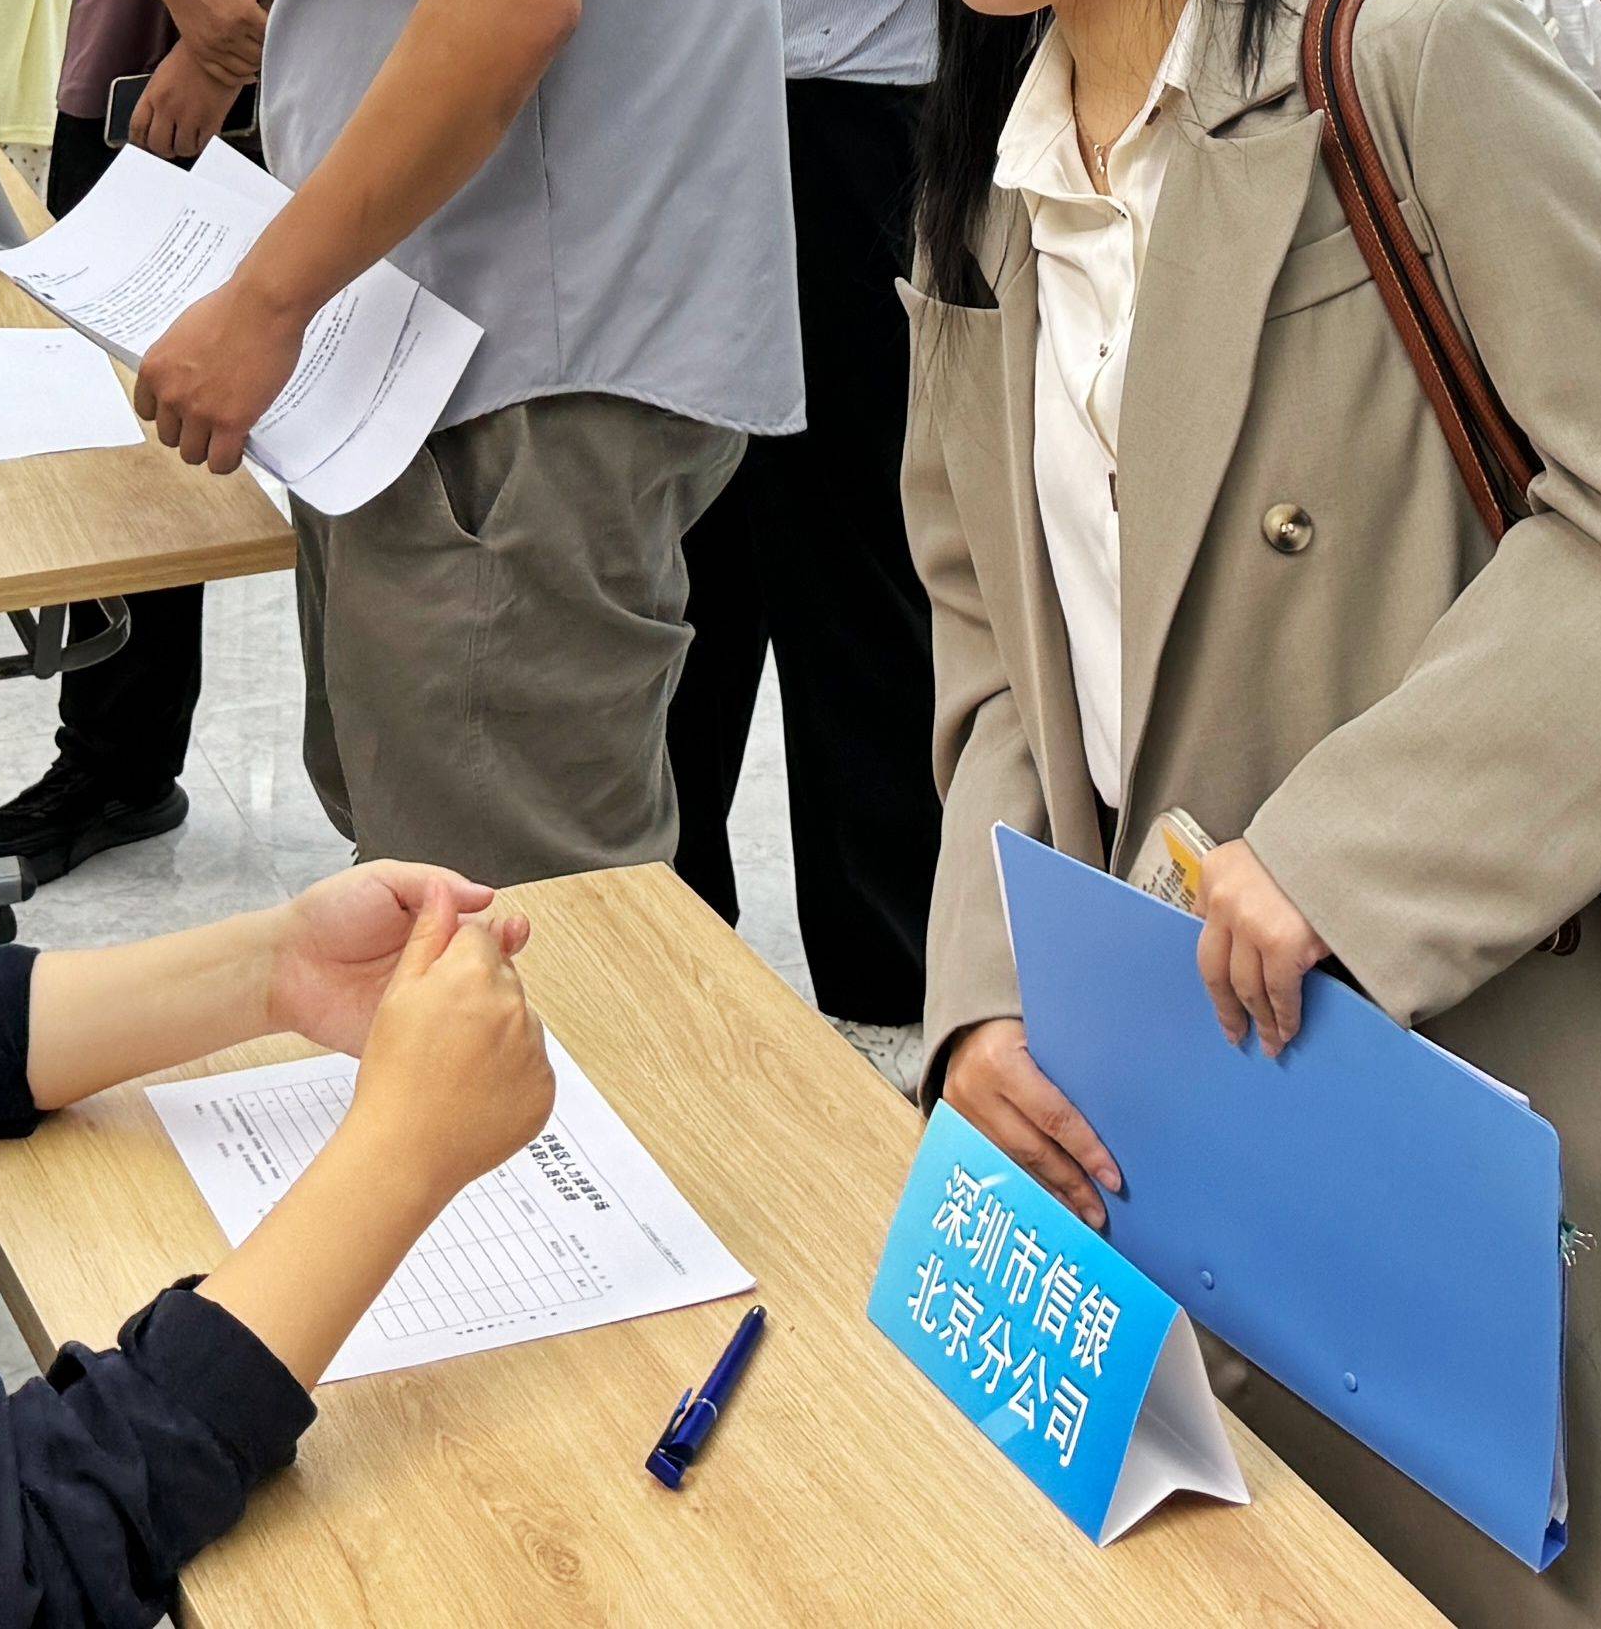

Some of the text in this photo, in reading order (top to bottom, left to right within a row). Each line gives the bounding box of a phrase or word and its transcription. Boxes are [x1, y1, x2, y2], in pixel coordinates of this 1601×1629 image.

[907, 1251, 1090, 1468] 北京分公司
[931, 1163, 1121, 1378] 深圳市信银
